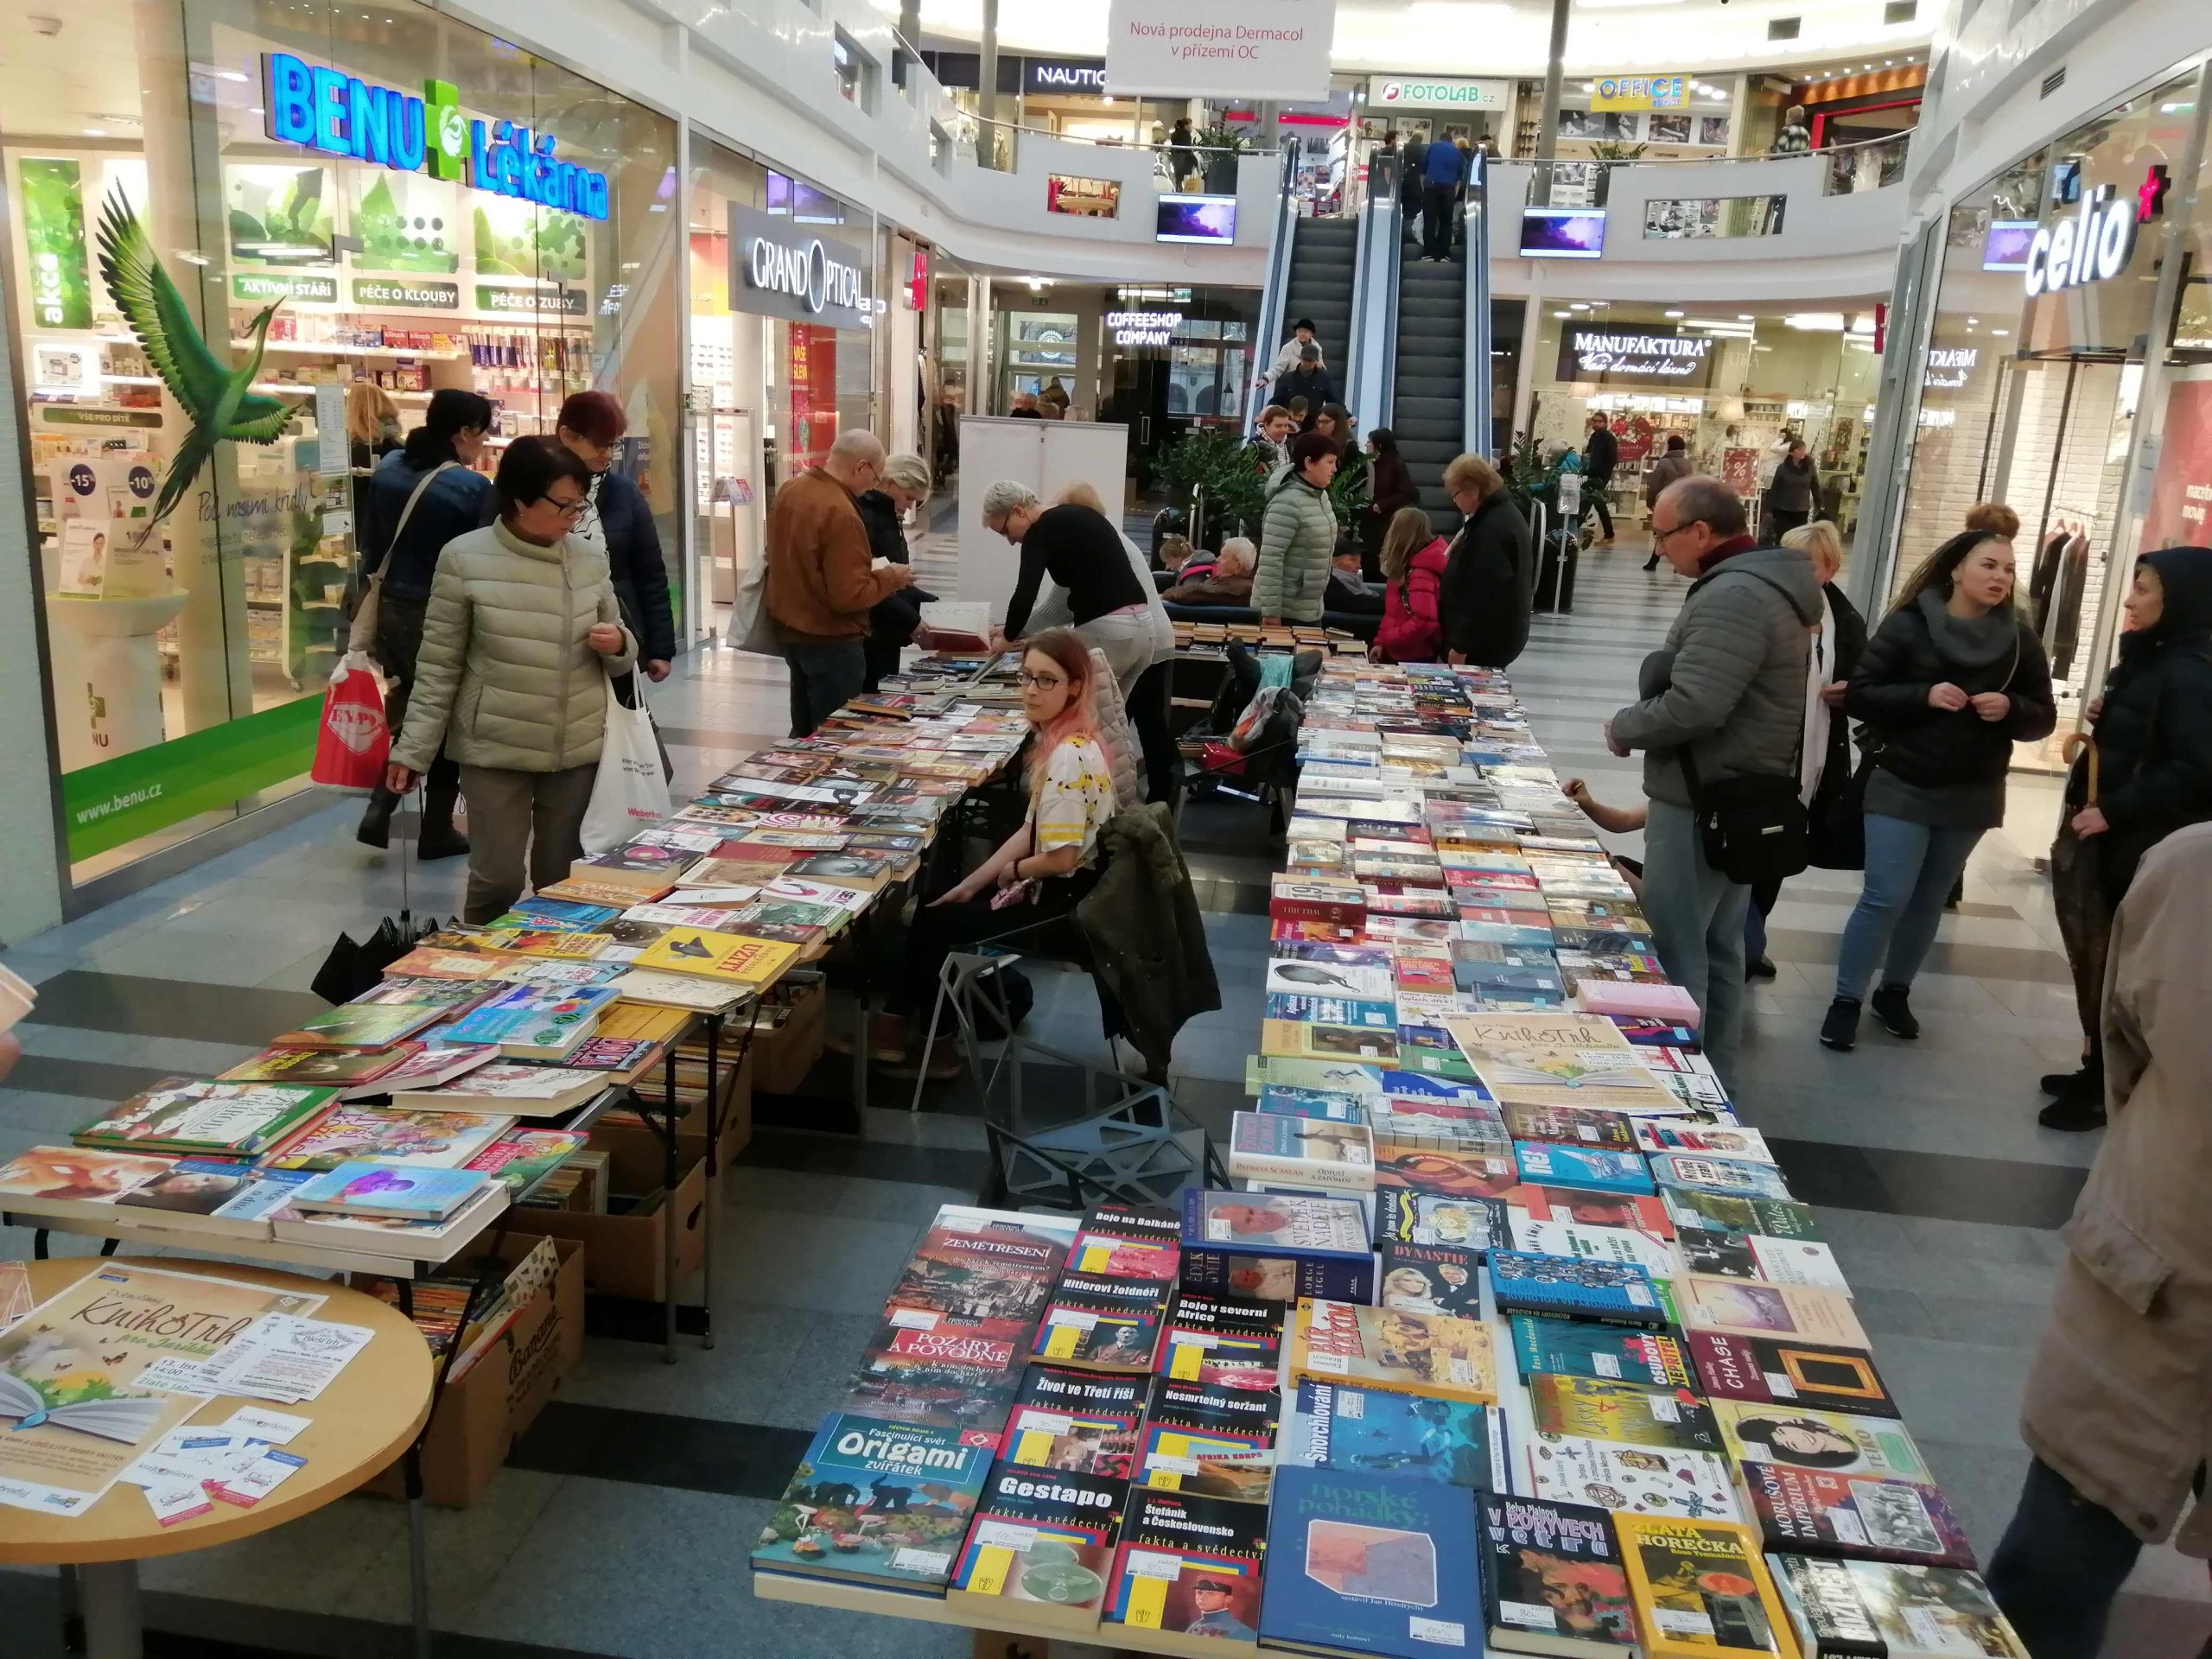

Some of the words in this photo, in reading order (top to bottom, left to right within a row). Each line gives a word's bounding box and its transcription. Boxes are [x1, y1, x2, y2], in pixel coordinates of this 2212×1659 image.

[1130, 22, 1166, 35] Nová
[1169, 24, 1232, 41] prodejna
[1236, 25, 1303, 41] Dermacol
[1171, 46, 1179, 56] v
[1183, 45, 1235, 60] přízemí
[1238, 46, 1259, 59] OC
[1402, 83, 1478, 102] FOTOLAB
[1599, 77, 1683, 99] OFFICE
[270, 54, 425, 172] BENU
[469, 119, 608, 220] Lékárna
[2024, 183, 2130, 296] celio
[242, 279, 295, 296] AKTIVNÍ
[296, 279, 332, 296] STÁŘÍ
[359, 284, 392, 301] PÉČE
[393, 289, 402, 301] O
[404, 288, 455, 305] KLOUBY
[491, 290, 524, 308] PÉČE
[525, 296, 536, 308] O
[539, 296, 575, 310] ZUBY
[1107, 312, 1182, 328] COFFEESHOP
[1116, 331, 1171, 345] COMPANY
[94, 413, 111, 422] PRO
[76, 781, 162, 825] www.benu.cz
[1236, 1163, 1268, 1173] PATRICIA
[1270, 1166, 1304, 1176] SCANLAN
[1096, 1211, 1121, 1224] Boje
[1137, 1217, 1181, 1230] Balkáně
[1090, 1226, 1118, 1236] fakta
[1133, 1231, 1181, 1243] svědectví
[944, 1237, 1052, 1258] ZEMĚTŘESENÍ
[1393, 1244, 1469, 1266] DYNASTIE
[1062, 1278, 1112, 1294] Hitlerovi
[1112, 1283, 1160, 1298] žoldnéři
[1304, 1262, 1313, 1296] EORGE
[1314, 1263, 1325, 1296] EIGEL
[1053, 1298, 1084, 1308] fakta
[1103, 1303, 1160, 1316] svědectví
[1176, 1308, 1215, 1323] Africe
[1179, 1300, 1209, 1312] Boje
[1219, 1306, 1268, 1319] severní
[1173, 1320, 1202, 1331] fakta
[1224, 1326, 1281, 1339] svědectví
[887, 1341, 902, 1352] A
[906, 1344, 1009, 1363] POVODNĚ
[917, 1332, 996, 1352] POŽÁRY
[1640, 1332, 1668, 1386] OSUDOVÝ
[1710, 1336, 1745, 1389] CHASE
[152, 1365, 183, 1376] 14:00
[1036, 1378, 1066, 1395] Život
[1068, 1385, 1081, 1395] ve
[1083, 1383, 1111, 1398] Třetí
[1112, 1385, 1134, 1400] říši
[1029, 1400, 1061, 1411] fakta
[1082, 1406, 1141, 1418] svědectví
[1165, 1389, 1226, 1408] Nesmrtelný
[1227, 1398, 1267, 1413] seržant
[1158, 1415, 1192, 1427] fakta
[1211, 1422, 1274, 1437] svědectví
[1299, 1383, 1332, 1463] Šnorchlování
[868, 1427, 923, 1445] Fascinující
[925, 1435, 946, 1446] svět
[836, 1431, 969, 1471] Origami
[1196, 1452, 1230, 1462] AFRIKA
[1233, 1451, 1263, 1460] KORPS
[1858, 1429, 1883, 1469] TEIKO
[864, 1459, 923, 1476] zvířátek
[999, 1477, 1113, 1509] Gestapo
[1311, 1482, 1420, 1509] norské
[1762, 1465, 1797, 1538] MORUŠOVÉ
[1145, 1504, 1187, 1519] Štefánik
[1504, 1501, 1528, 1514] Belva
[1529, 1504, 1559, 1519] Plainová
[1784, 1471, 1818, 1538] IMPÉRIUM
[988, 1506, 1025, 1521] fakta
[1046, 1516, 1113, 1532] svědectví
[1152, 1516, 1235, 1538] Československo
[1487, 1508, 1502, 1526] V
[1507, 1508, 1605, 1542] PORYVECH
[1138, 1534, 1176, 1549] fakta
[1197, 1542, 1264, 1560] svědectví
[1636, 1533, 1745, 1555] HOREČKA
[1370, 1597, 1383, 1605] Jan
